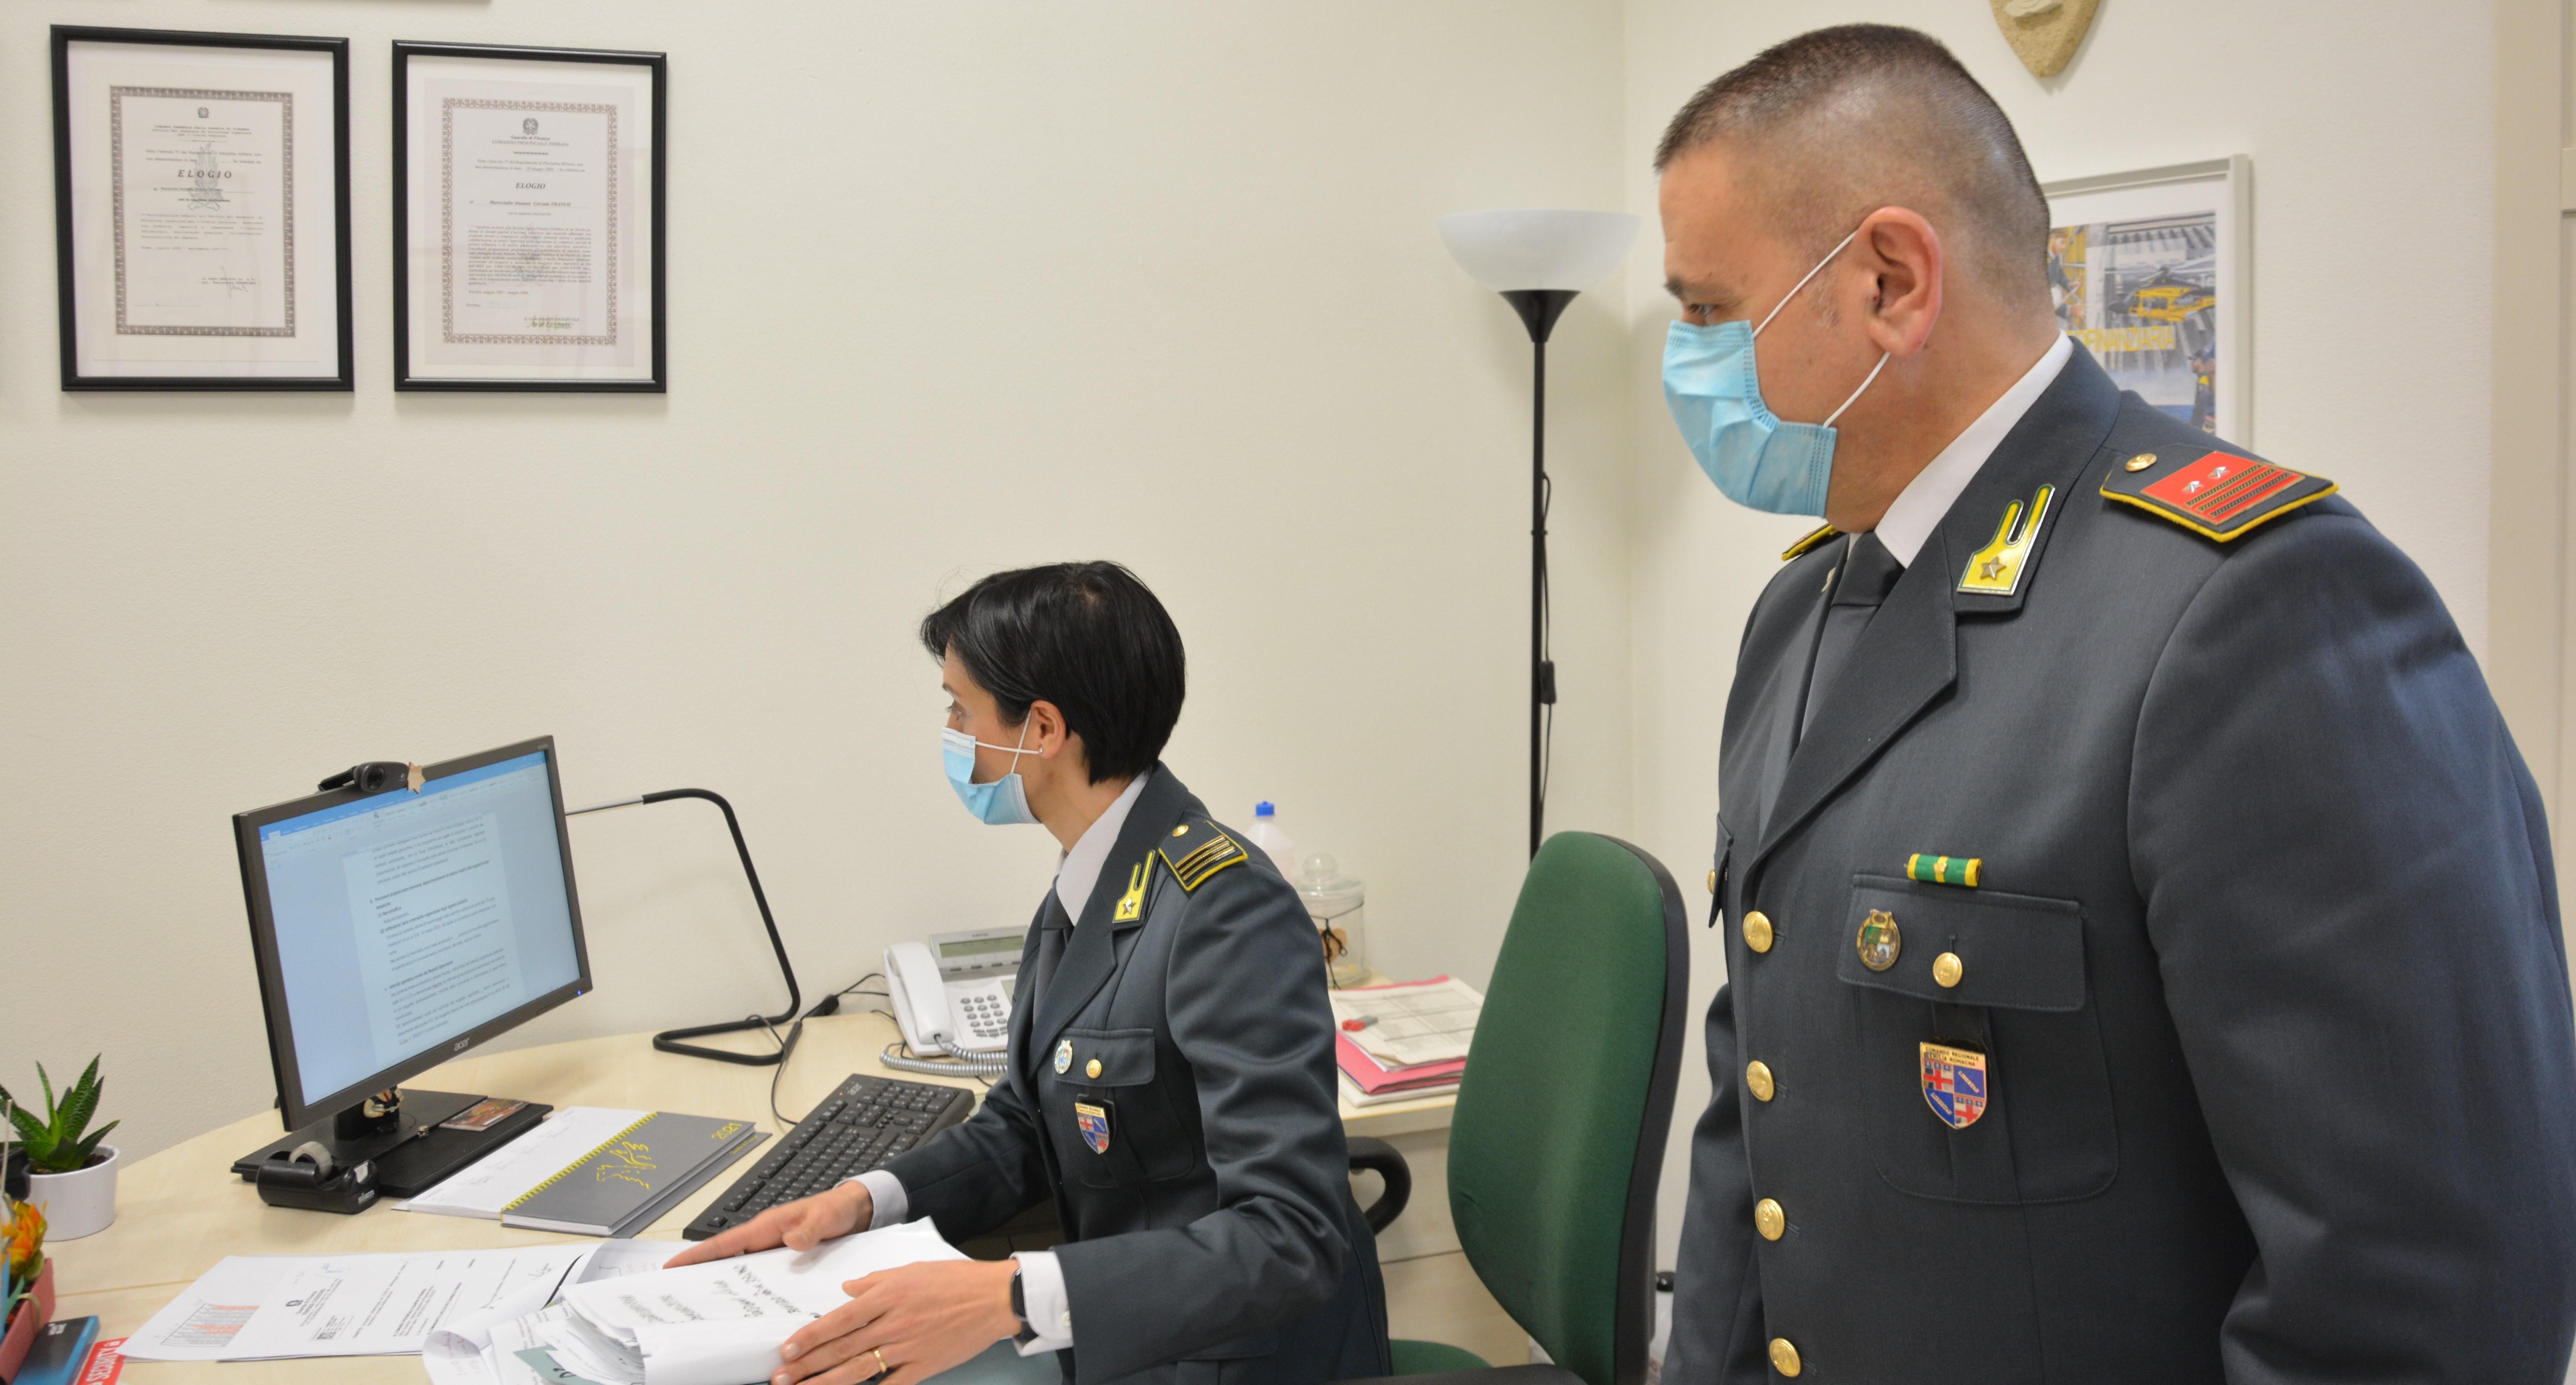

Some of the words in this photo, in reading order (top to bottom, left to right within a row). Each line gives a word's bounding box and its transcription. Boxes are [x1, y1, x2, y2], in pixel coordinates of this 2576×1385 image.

[178, 170, 232, 178] ELOGIO
[454, 1038, 470, 1051] acer
[1952, 1051, 1979, 1061] REGIONALE
[711, 1122, 742, 1139] 2021
[85, 1347, 119, 1382] SECURITY
